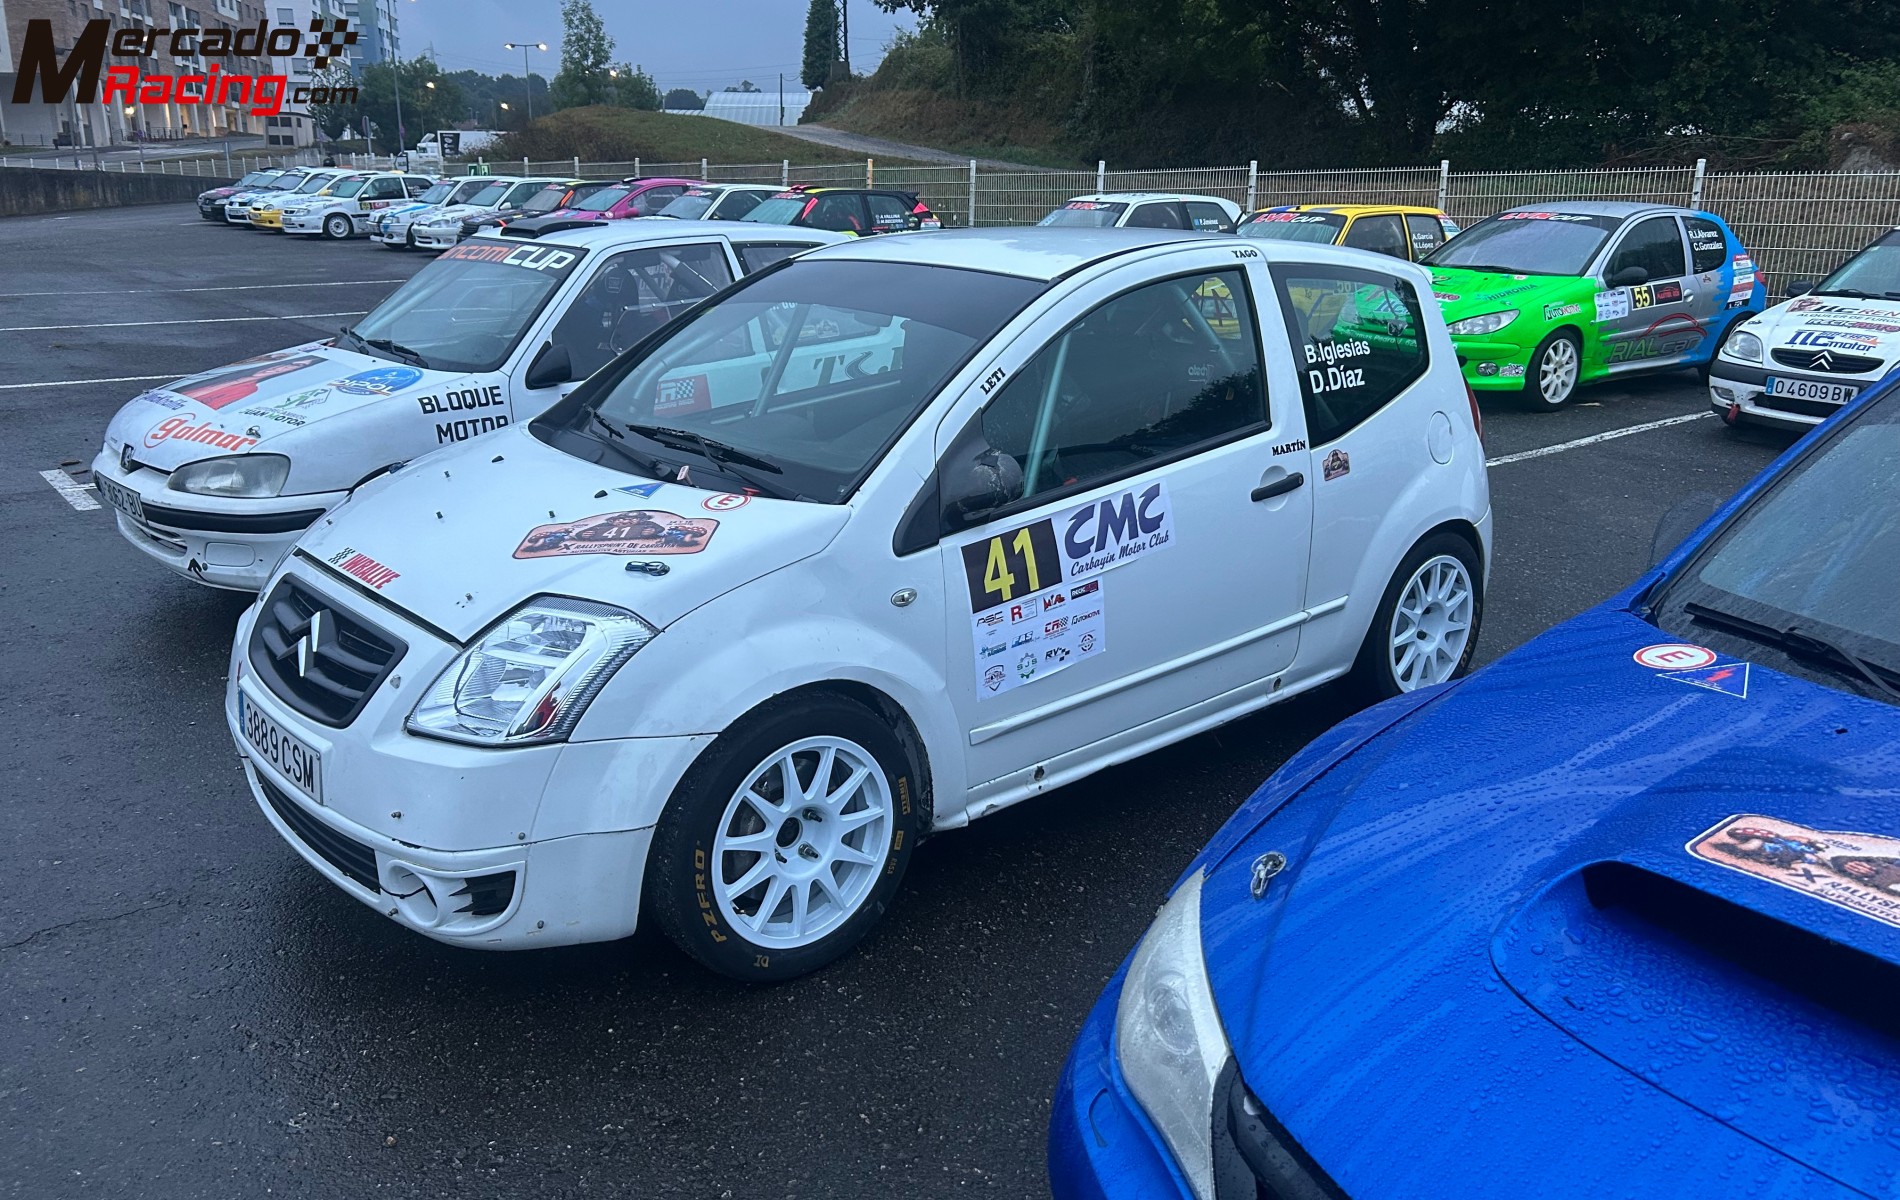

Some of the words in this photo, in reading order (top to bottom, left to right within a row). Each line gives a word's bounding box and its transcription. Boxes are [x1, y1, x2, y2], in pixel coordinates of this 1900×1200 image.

[1231, 250, 1258, 259] YAGO
[1634, 287, 1651, 307] 55
[1304, 338, 1371, 365] B.Iglesias
[980, 366, 1006, 395] LETI
[1309, 364, 1366, 394] D.Díaz
[1787, 381, 1828, 399] 4609
[418, 385, 505, 415] BLOQUE
[1271, 439, 1307, 456] MARTÍN
[602, 526, 631, 538] 41
[1064, 483, 1165, 560] CMC
[1118, 542, 1147, 559] Motor
[1149, 530, 1169, 549] Club
[984, 527, 1040, 602] 41
[246, 704, 279, 764] 3889
[282, 735, 315, 793] CSM
